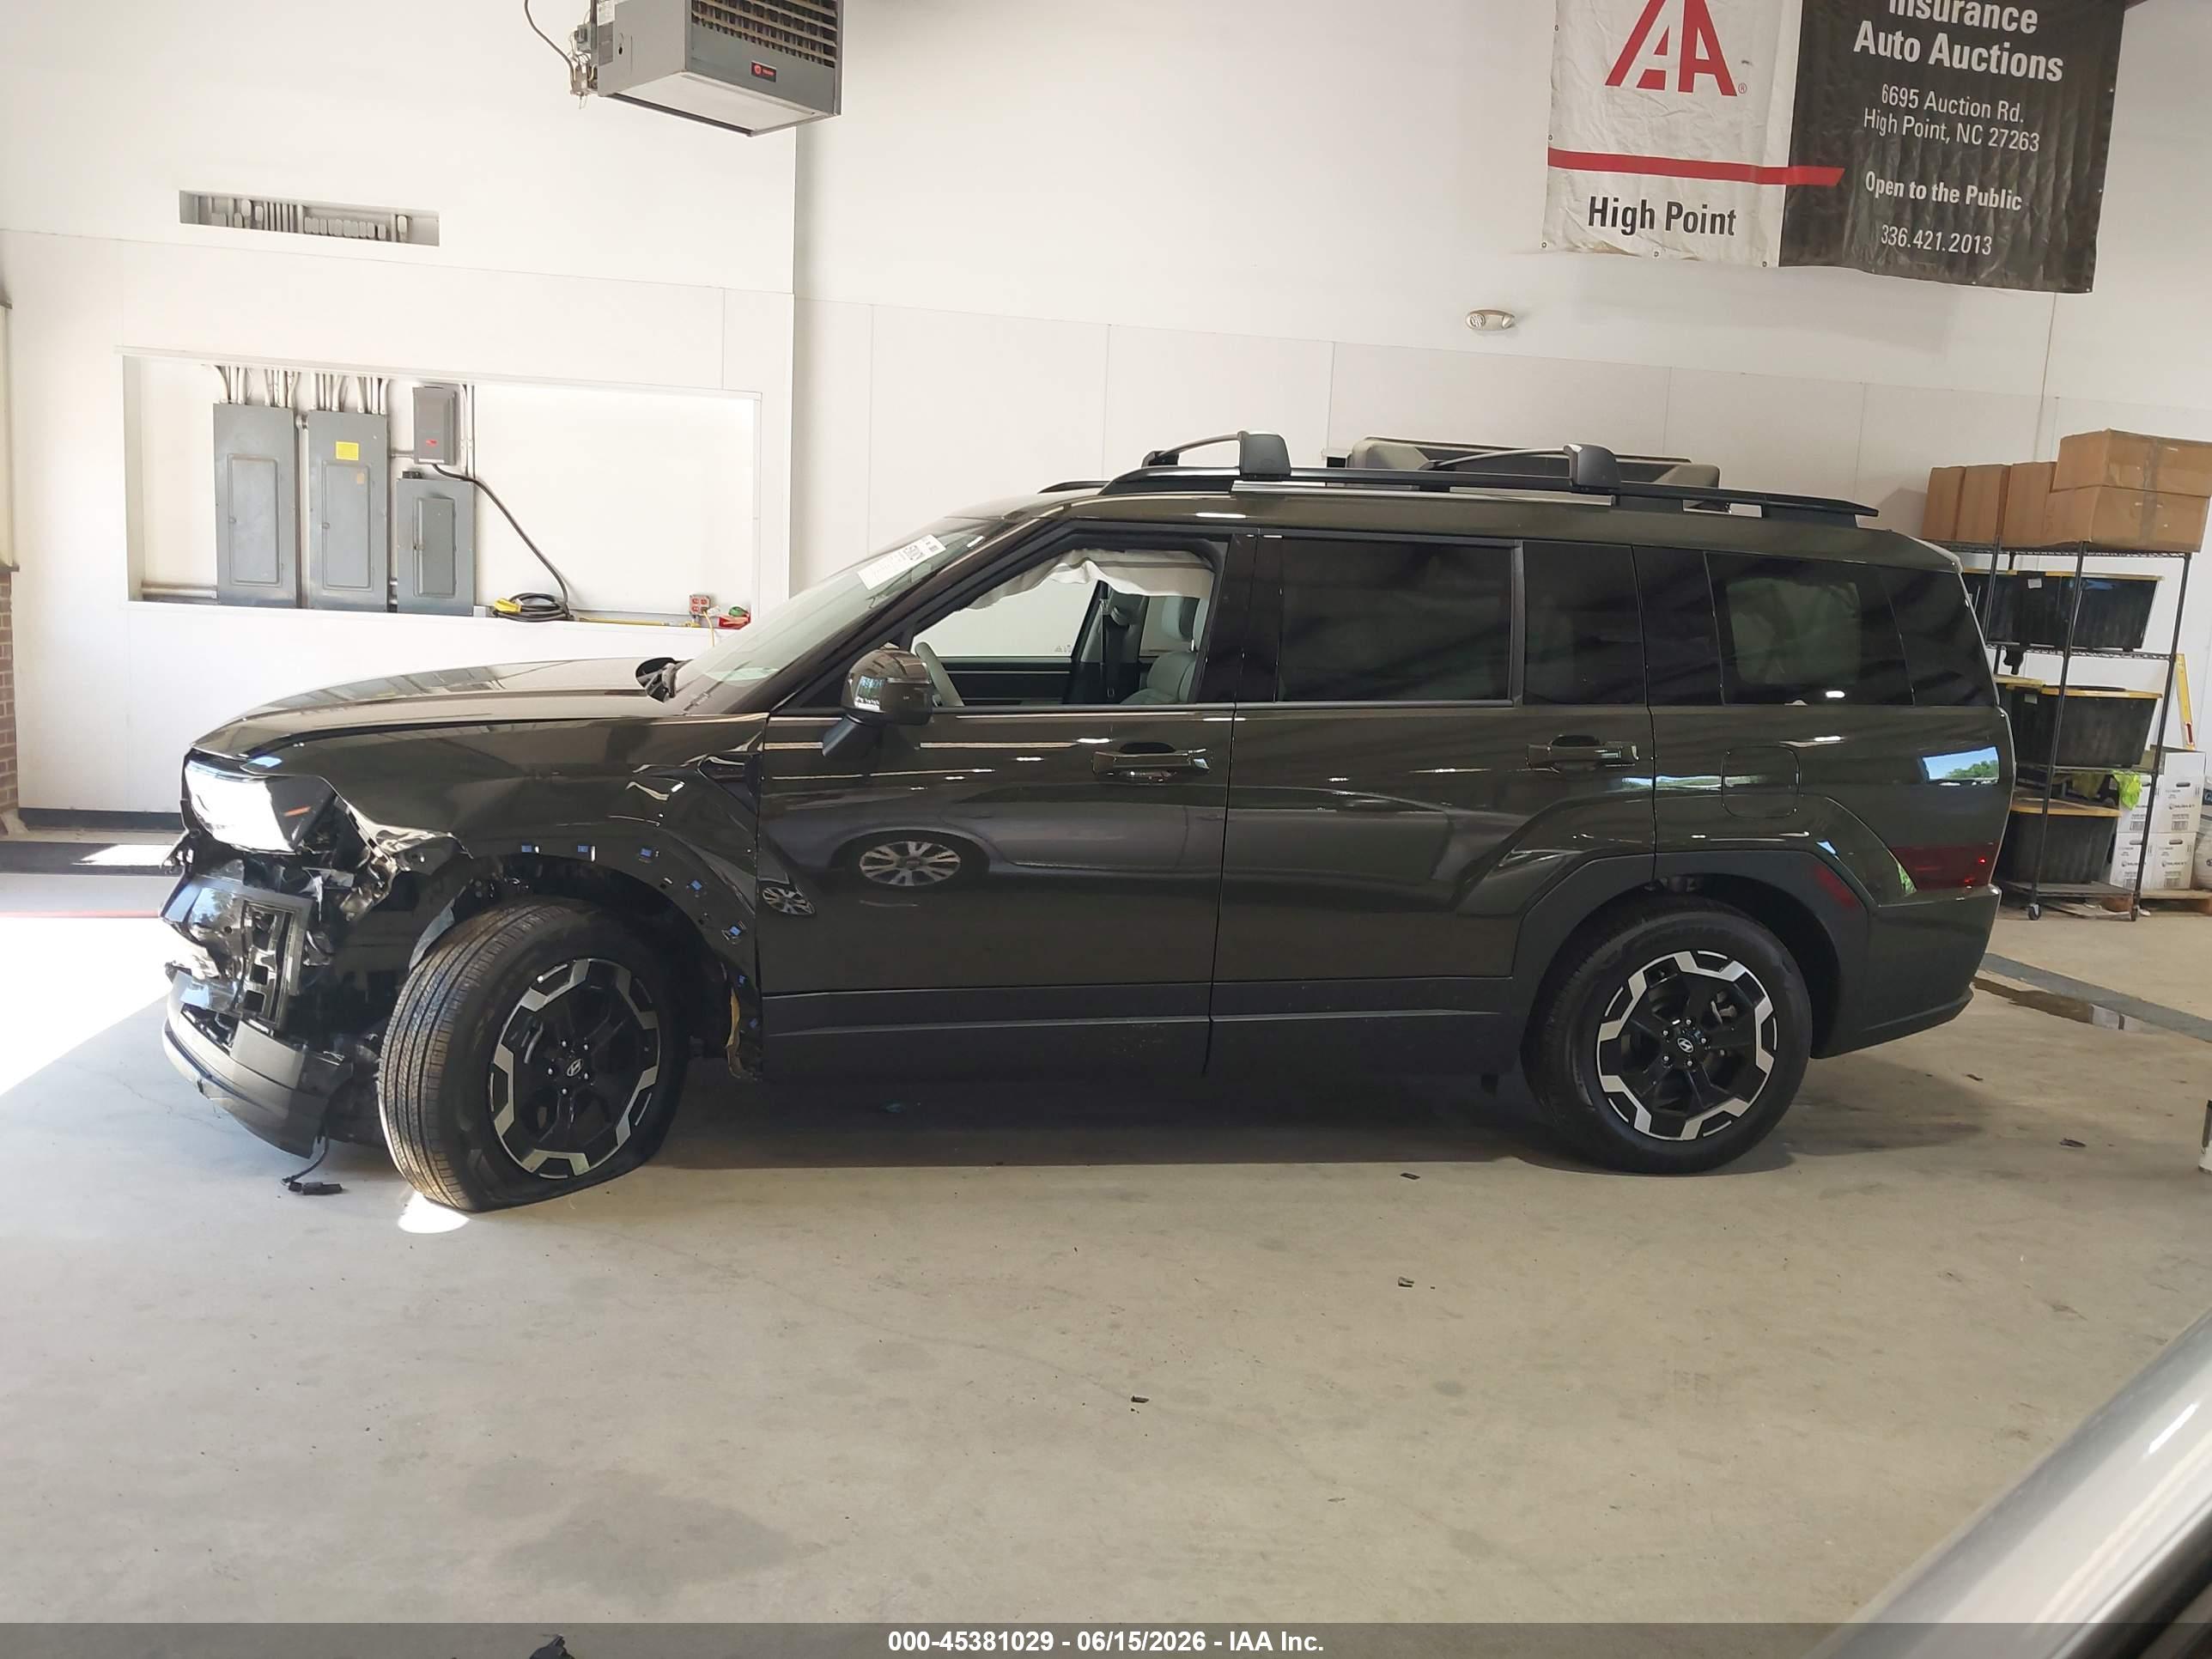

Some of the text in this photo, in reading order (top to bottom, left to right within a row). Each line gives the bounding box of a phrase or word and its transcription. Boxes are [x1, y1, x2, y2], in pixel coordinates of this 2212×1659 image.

[1853, 20, 2063, 82] Auto Auctions
[1881, 83, 2024, 123] 6695 Auction Rd.
[1863, 107, 2040, 152] High Point, NC 27263
[1865, 171, 2023, 211] Open to the Public
[1588, 195, 1736, 236] High Point
[1881, 224, 1993, 255] 336.421.2013
